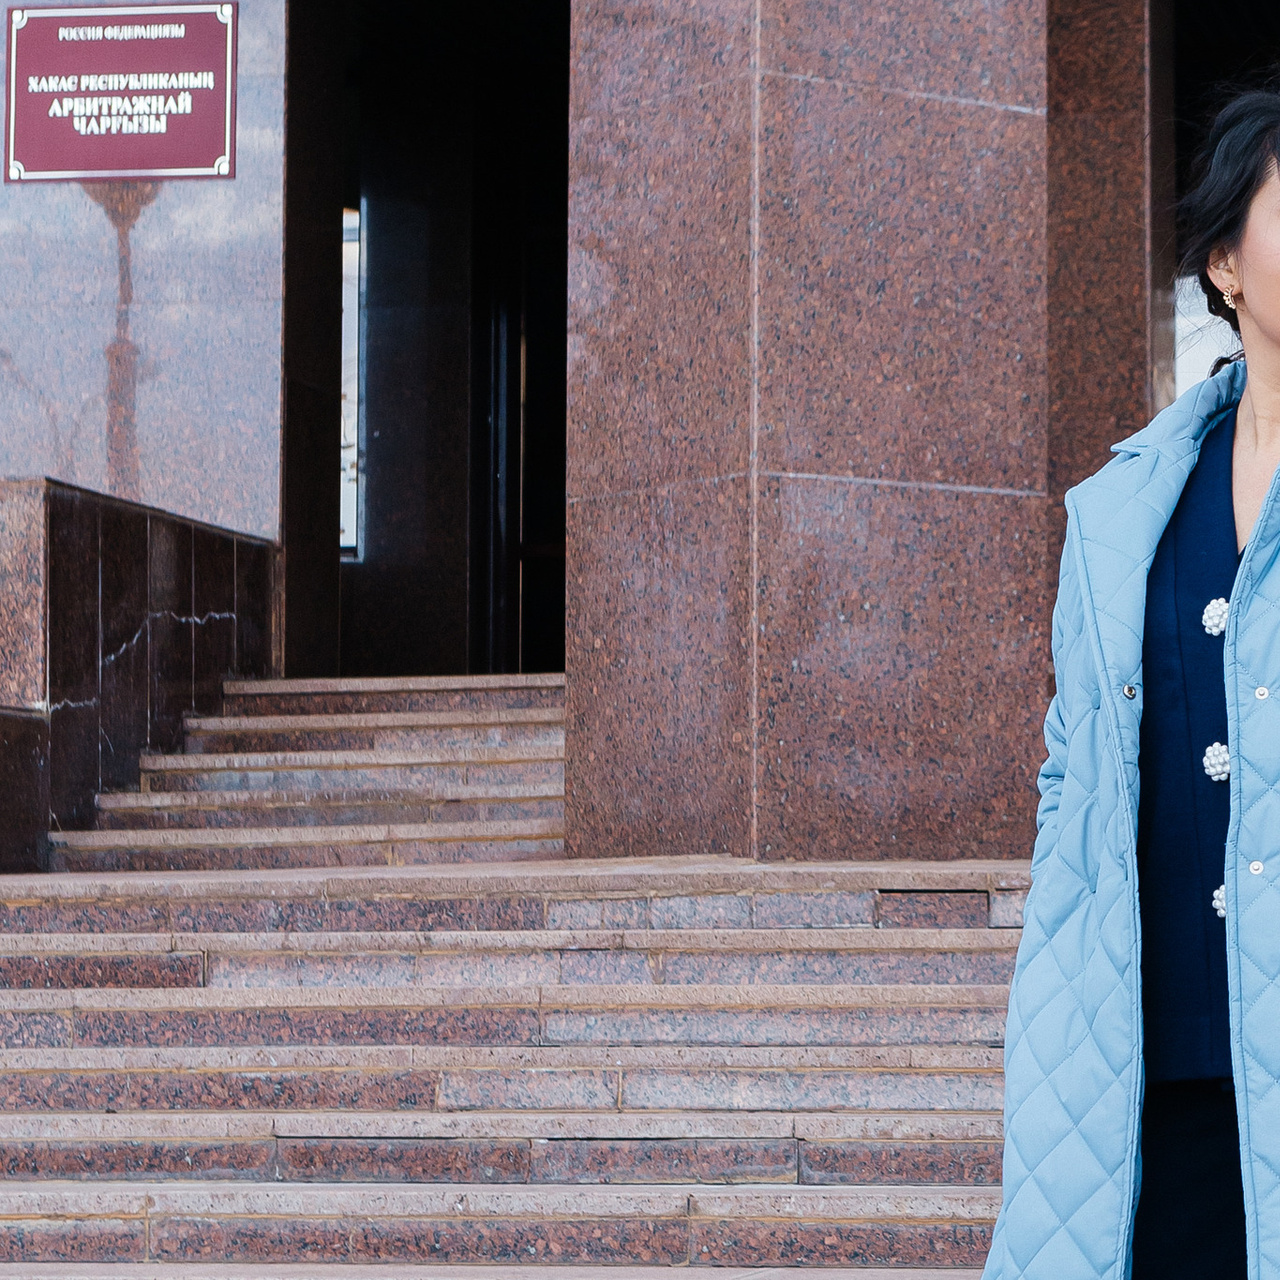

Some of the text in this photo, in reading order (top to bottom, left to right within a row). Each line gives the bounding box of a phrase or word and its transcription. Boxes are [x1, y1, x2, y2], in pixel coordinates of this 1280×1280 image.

[58, 25, 103, 41] РОССИЯ
[28, 74, 78, 93] ХАКАС
[48, 91, 192, 117] АРБИТРАЖНАЙ
